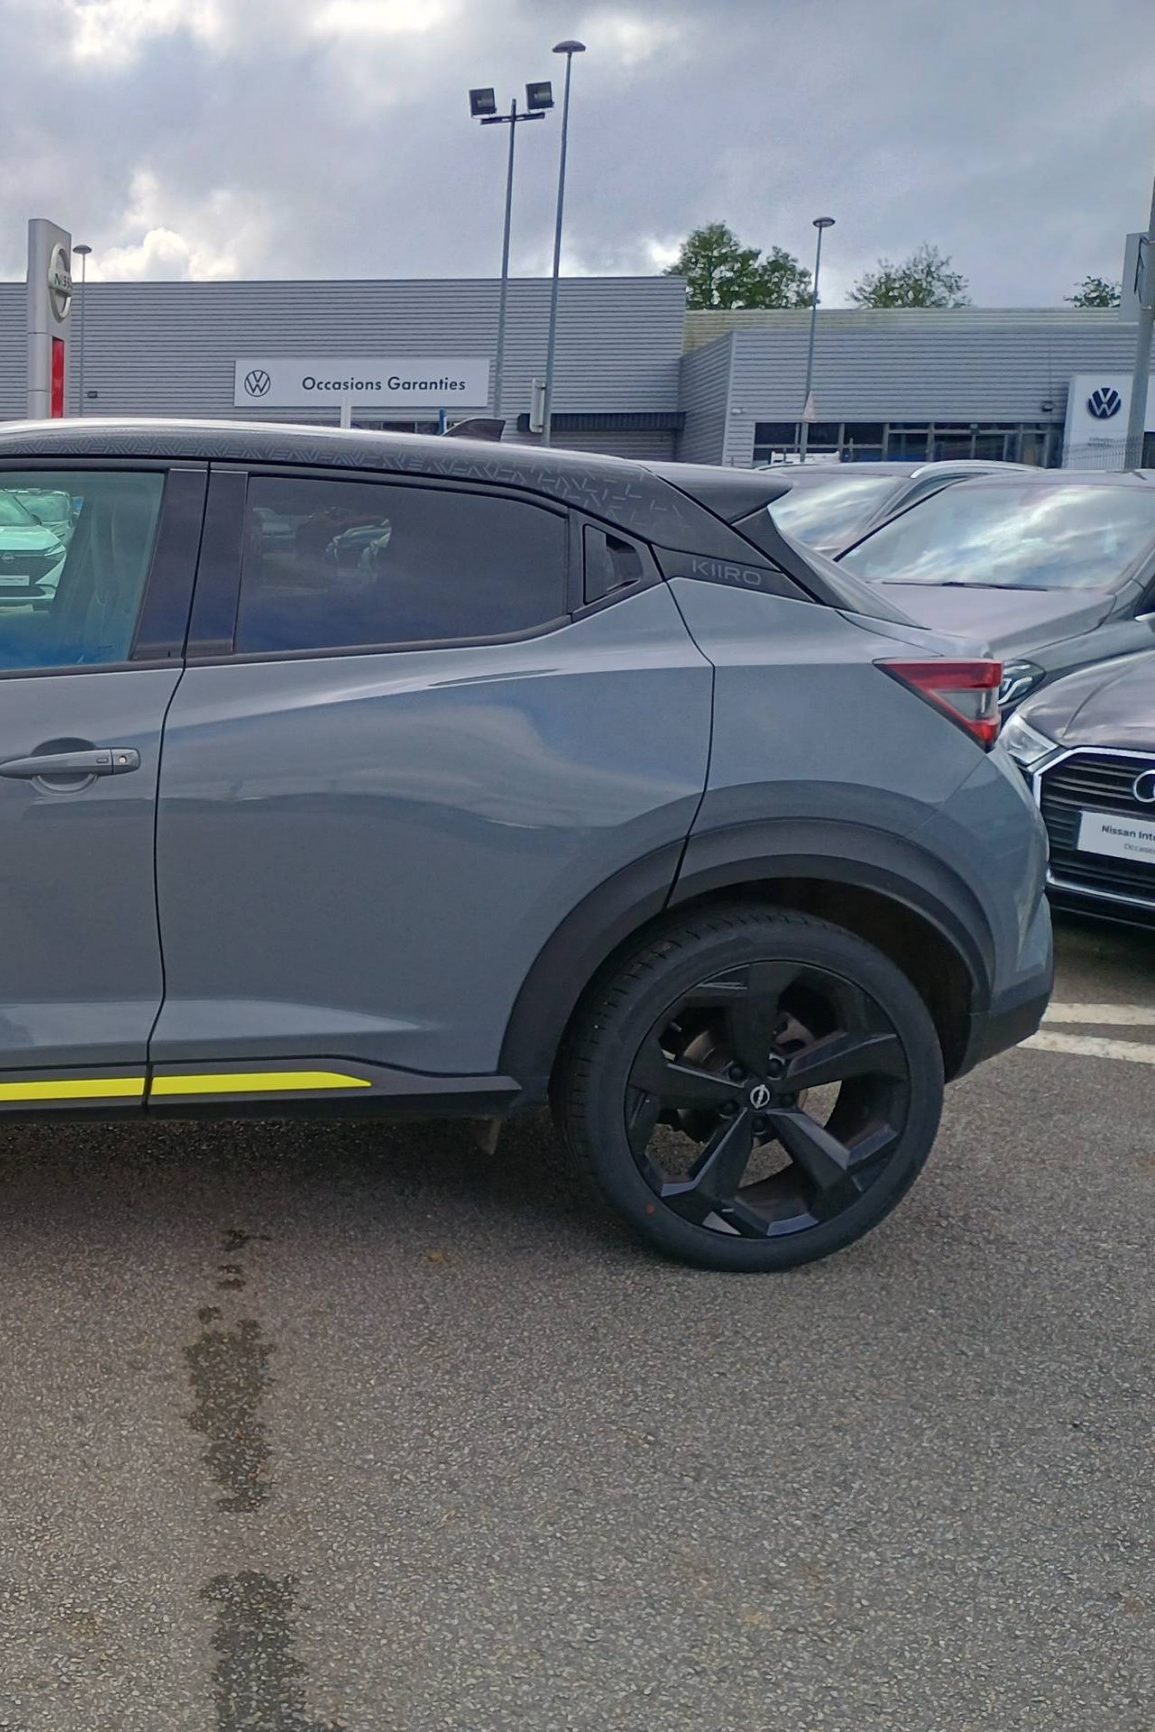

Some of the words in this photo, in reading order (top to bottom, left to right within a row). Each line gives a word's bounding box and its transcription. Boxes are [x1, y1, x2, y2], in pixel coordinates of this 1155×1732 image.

[302, 376, 382, 391] Occasions
[387, 376, 466, 391] Garanties
[692, 560, 762, 586] KIIRO
[1101, 825, 1136, 838] Nissan
